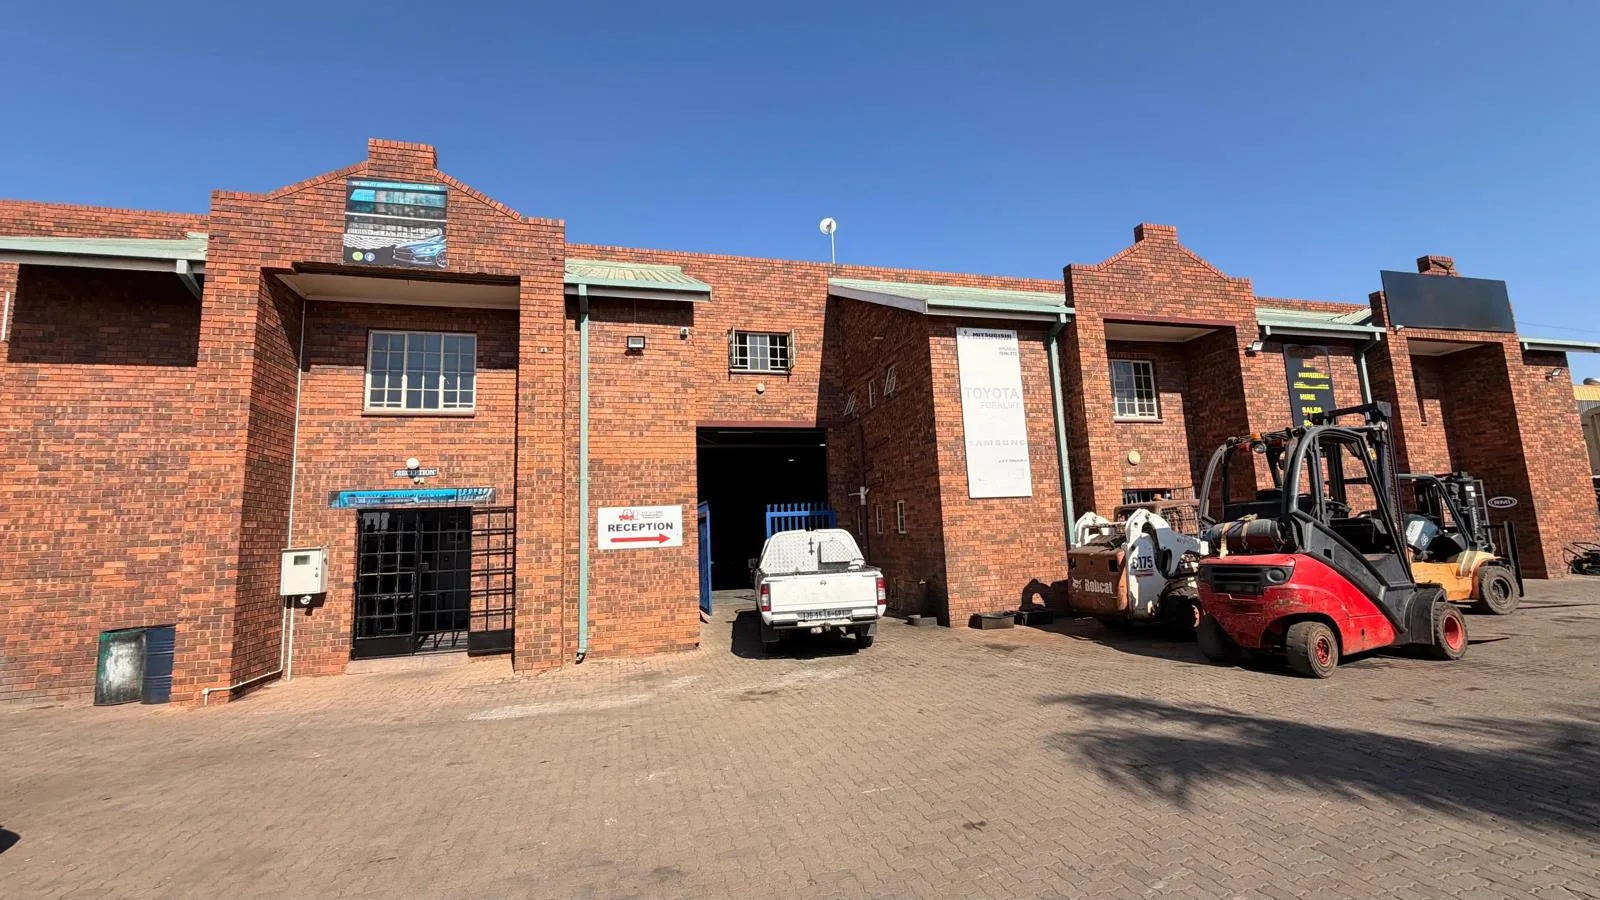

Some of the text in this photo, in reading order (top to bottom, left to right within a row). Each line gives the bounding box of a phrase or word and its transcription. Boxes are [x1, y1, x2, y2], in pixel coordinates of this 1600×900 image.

[964, 387, 1020, 399] TOYOTA
[608, 522, 673, 532] RECEPTION
[1085, 579, 1113, 594] Bobcat
